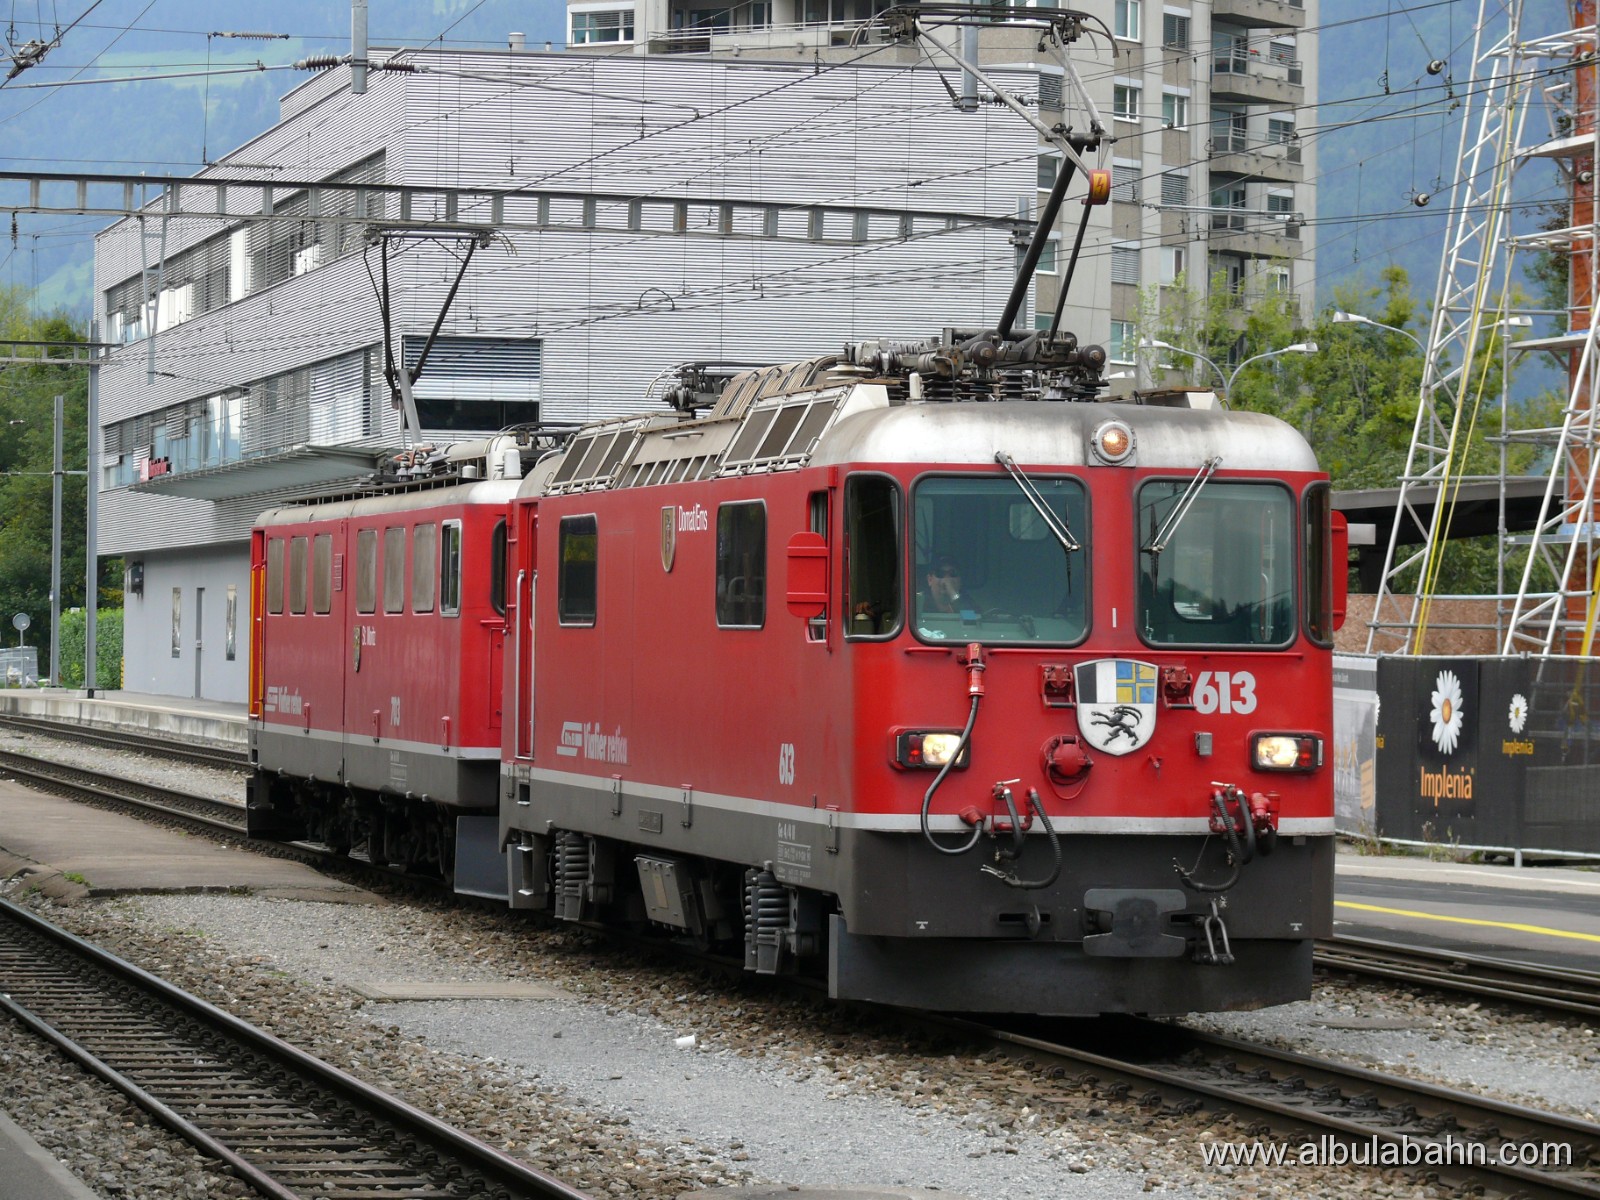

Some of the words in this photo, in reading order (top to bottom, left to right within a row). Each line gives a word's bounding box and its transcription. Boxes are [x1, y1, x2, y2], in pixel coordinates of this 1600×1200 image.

[1192, 670, 1258, 714] 613
[779, 743, 795, 785] 613
[1502, 738, 1533, 758] Implenia
[1420, 764, 1473, 807] Implenia
